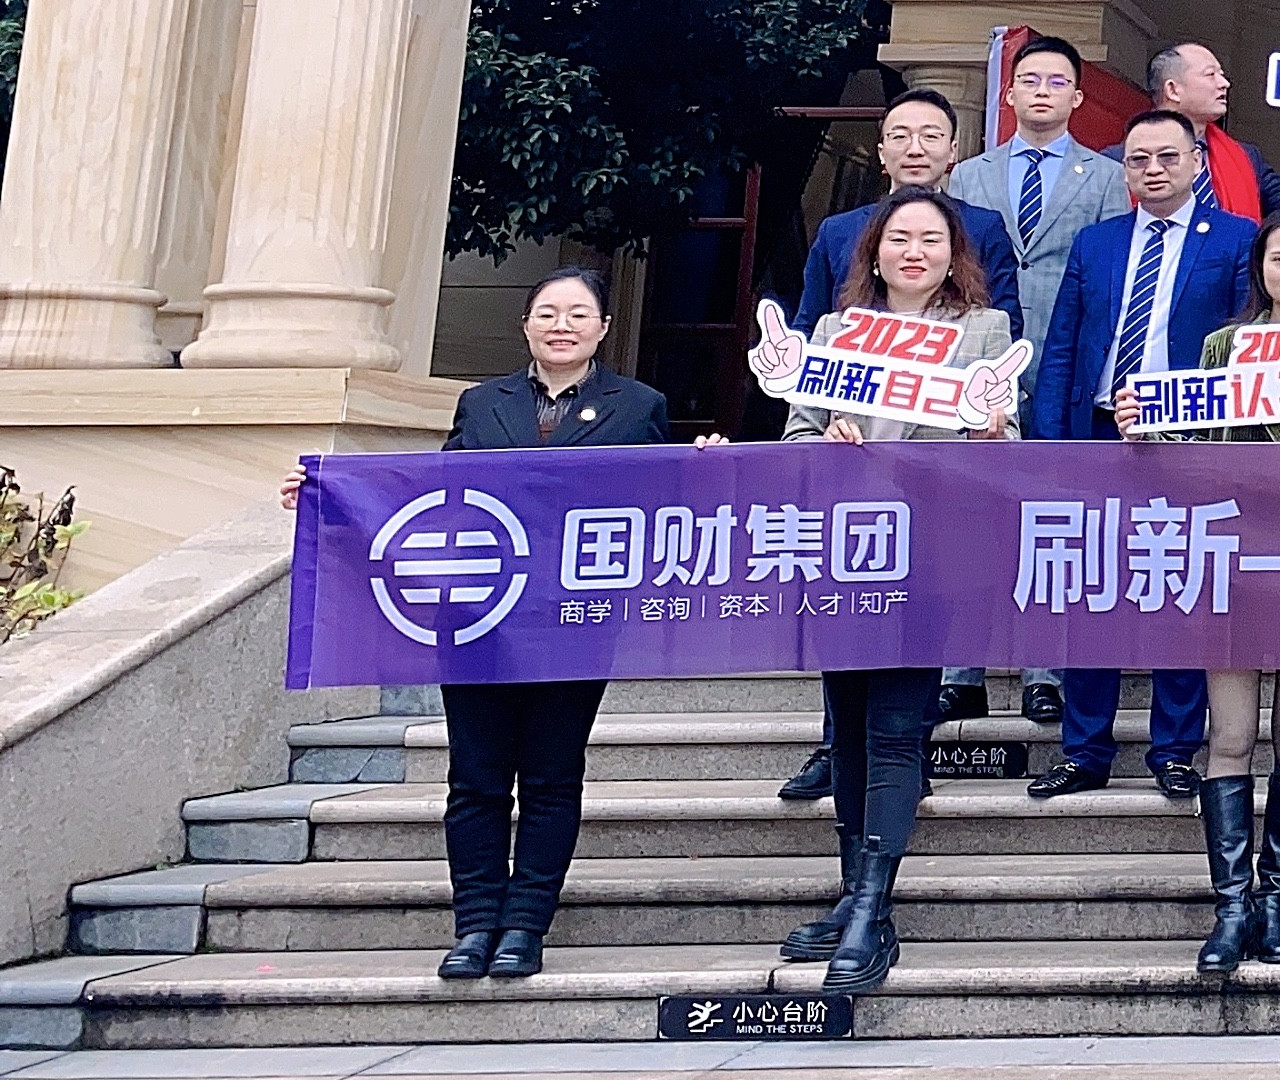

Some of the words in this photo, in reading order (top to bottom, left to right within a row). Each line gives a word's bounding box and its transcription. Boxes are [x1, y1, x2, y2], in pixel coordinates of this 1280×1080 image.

[831, 312, 959, 365] 2023
[796, 355, 964, 418] 刷新自己
[560, 501, 911, 591] 国财集团
[930, 746, 1008, 765] 小心台阶
[933, 766, 955, 774] MIND
[958, 766, 974, 774] THE
[732, 1000, 829, 1023] 小心台阶
[736, 1024, 763, 1034] MIND
[765, 1024, 787, 1034] THE
[789, 1024, 823, 1034] STEPS
